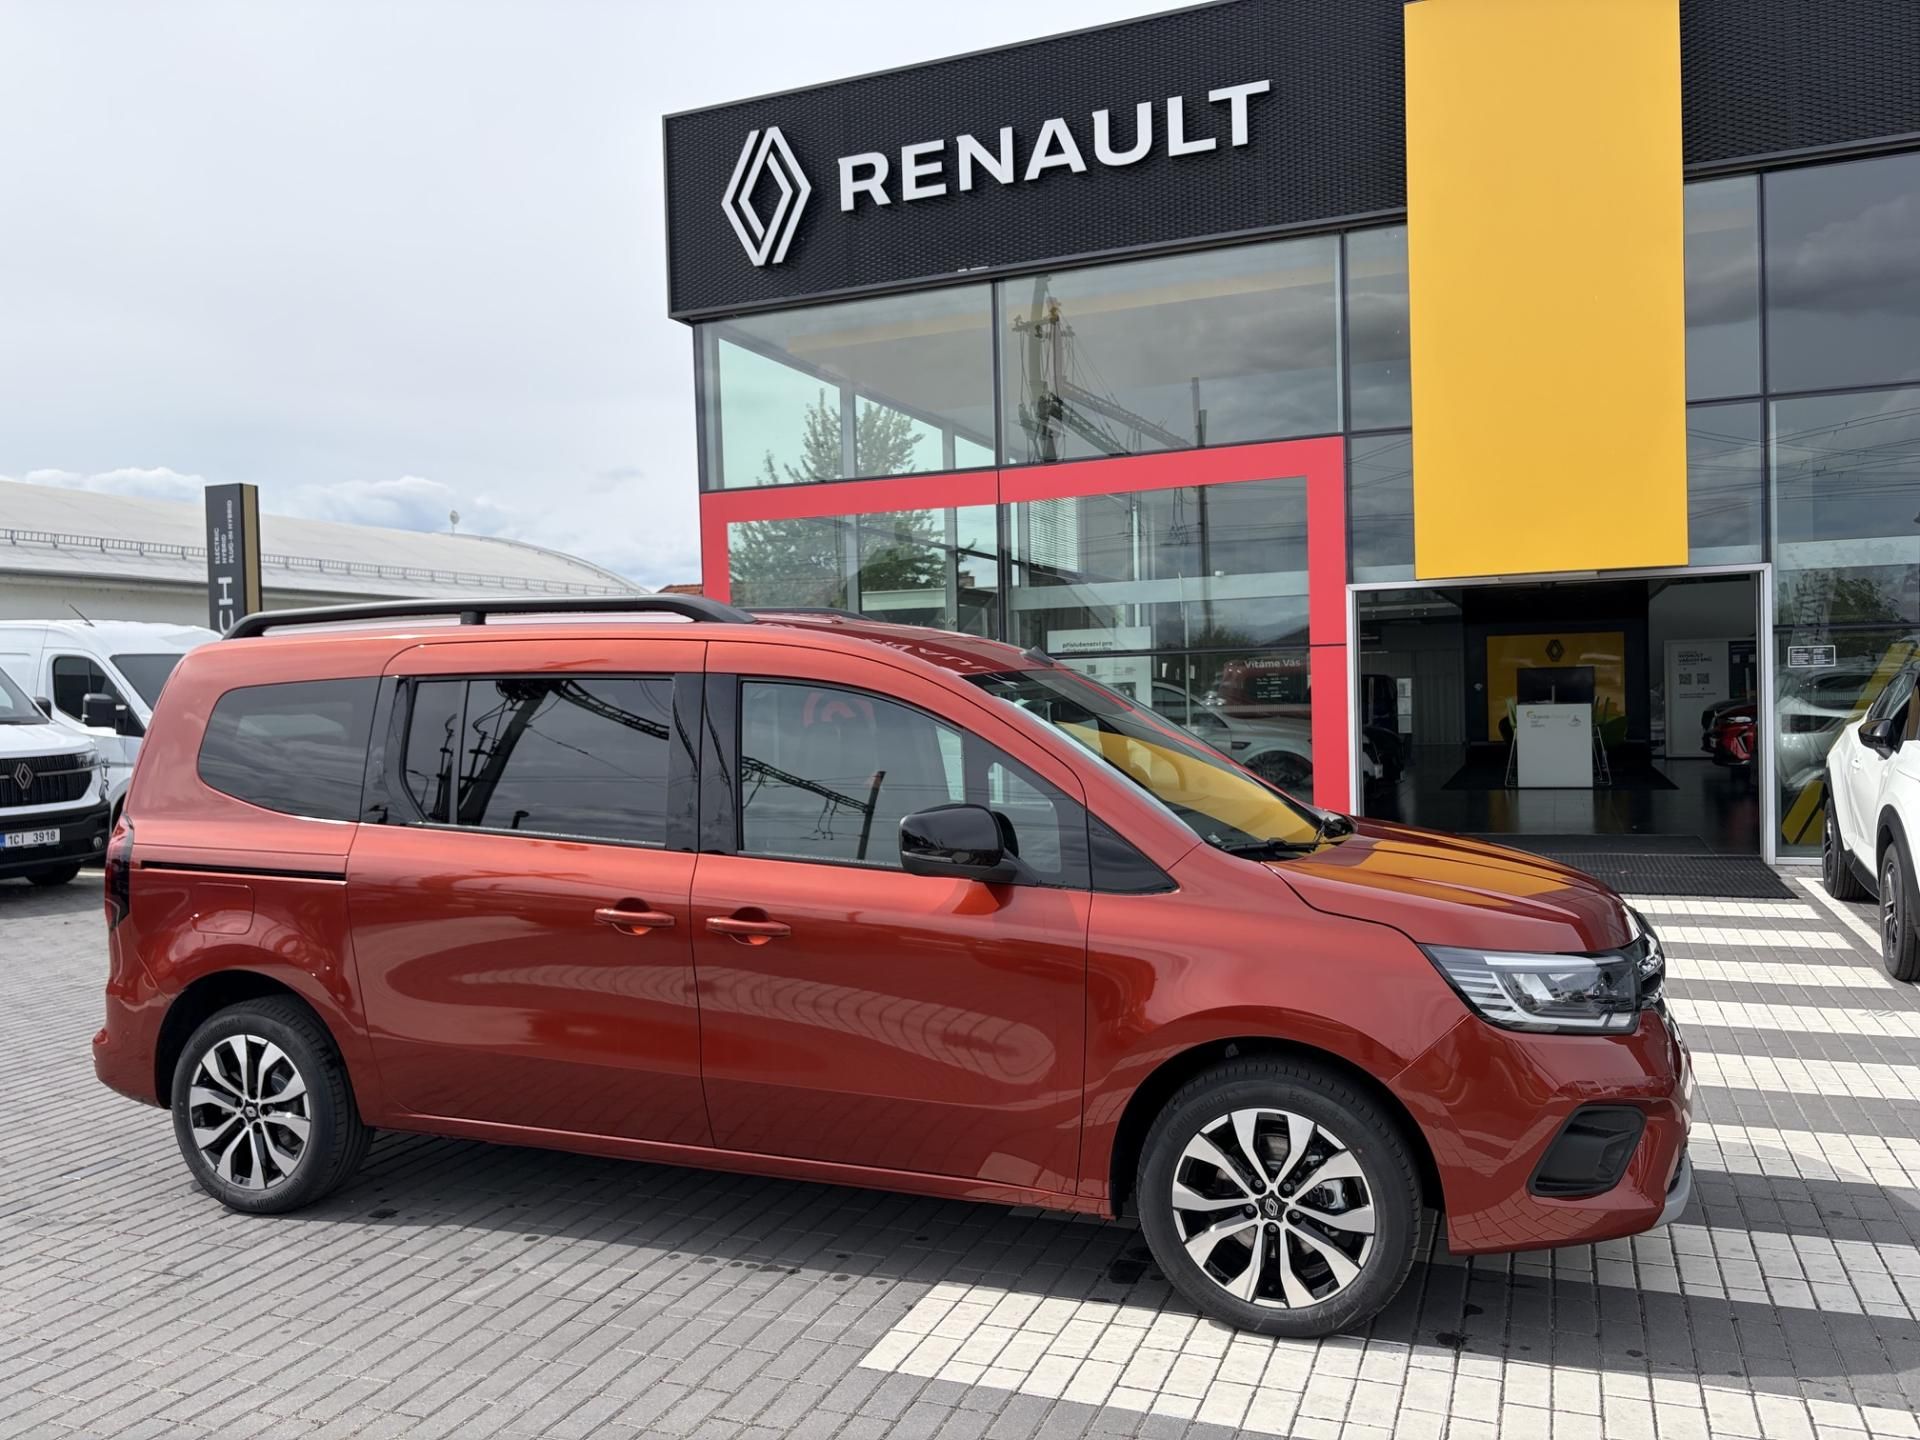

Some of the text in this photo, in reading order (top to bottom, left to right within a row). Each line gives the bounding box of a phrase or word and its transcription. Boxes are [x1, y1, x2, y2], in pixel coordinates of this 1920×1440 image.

[837, 79, 1271, 212] RENAULT
[1244, 659, 1280, 669] Vitáme
[32, 830, 56, 842] 3918
